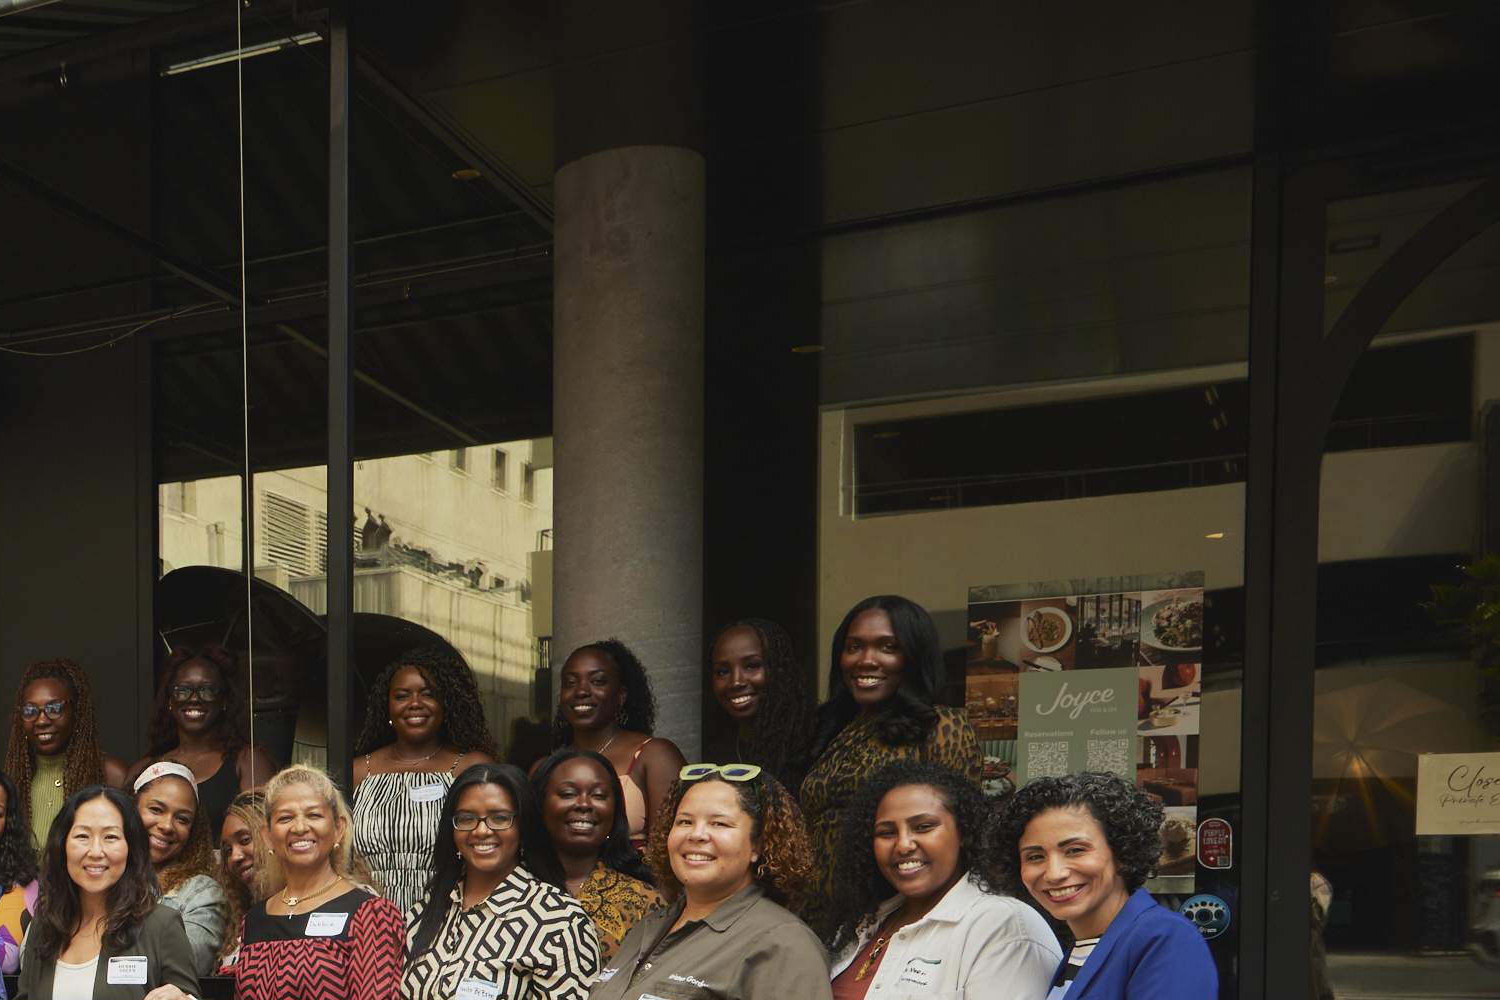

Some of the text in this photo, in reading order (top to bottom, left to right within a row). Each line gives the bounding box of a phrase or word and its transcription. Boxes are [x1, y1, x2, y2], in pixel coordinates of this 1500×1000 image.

[1035, 682, 1114, 719] Joyce
[1024, 730, 1074, 738] Reservations
[1440, 793, 1486, 808] Private
[1203, 829, 1226, 837] PEOPLE
[1203, 837, 1227, 845] LOVE US
